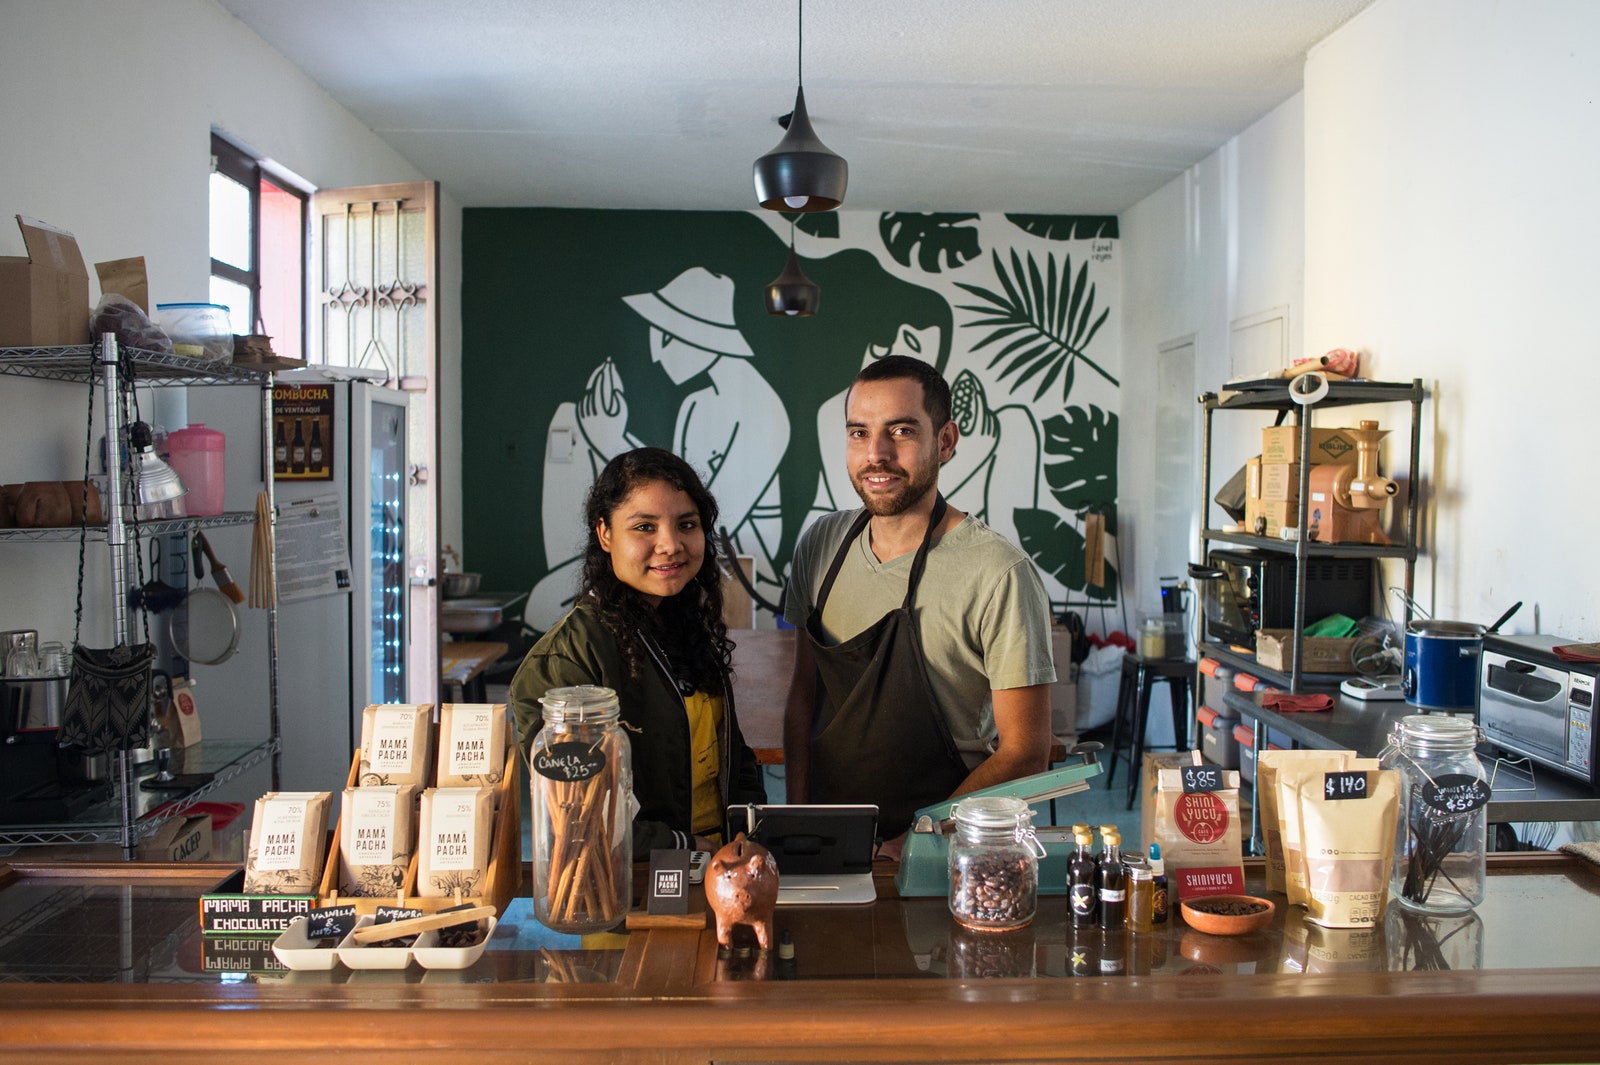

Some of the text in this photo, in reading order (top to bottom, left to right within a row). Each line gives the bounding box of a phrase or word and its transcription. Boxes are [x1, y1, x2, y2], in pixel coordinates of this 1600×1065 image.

[275, 406, 283, 414] DE
[284, 406, 304, 414] VENTA
[378, 749, 408, 760] PACHA
[455, 751, 485, 762] PACHA
[538, 754, 581, 769] CANELA
[1185, 768, 1216, 790] $85
[1185, 796, 1215, 808] SHINI
[1187, 808, 1217, 820] YUCU
[264, 845, 296, 857] PACHA
[355, 840, 387, 851] PACHA
[436, 844, 468, 856] PACHA
[1186, 873, 1233, 887] SHINIYUCU
[204, 900, 309, 913] MAMA PACHA
[213, 918, 288, 930] CHOCOLATE
